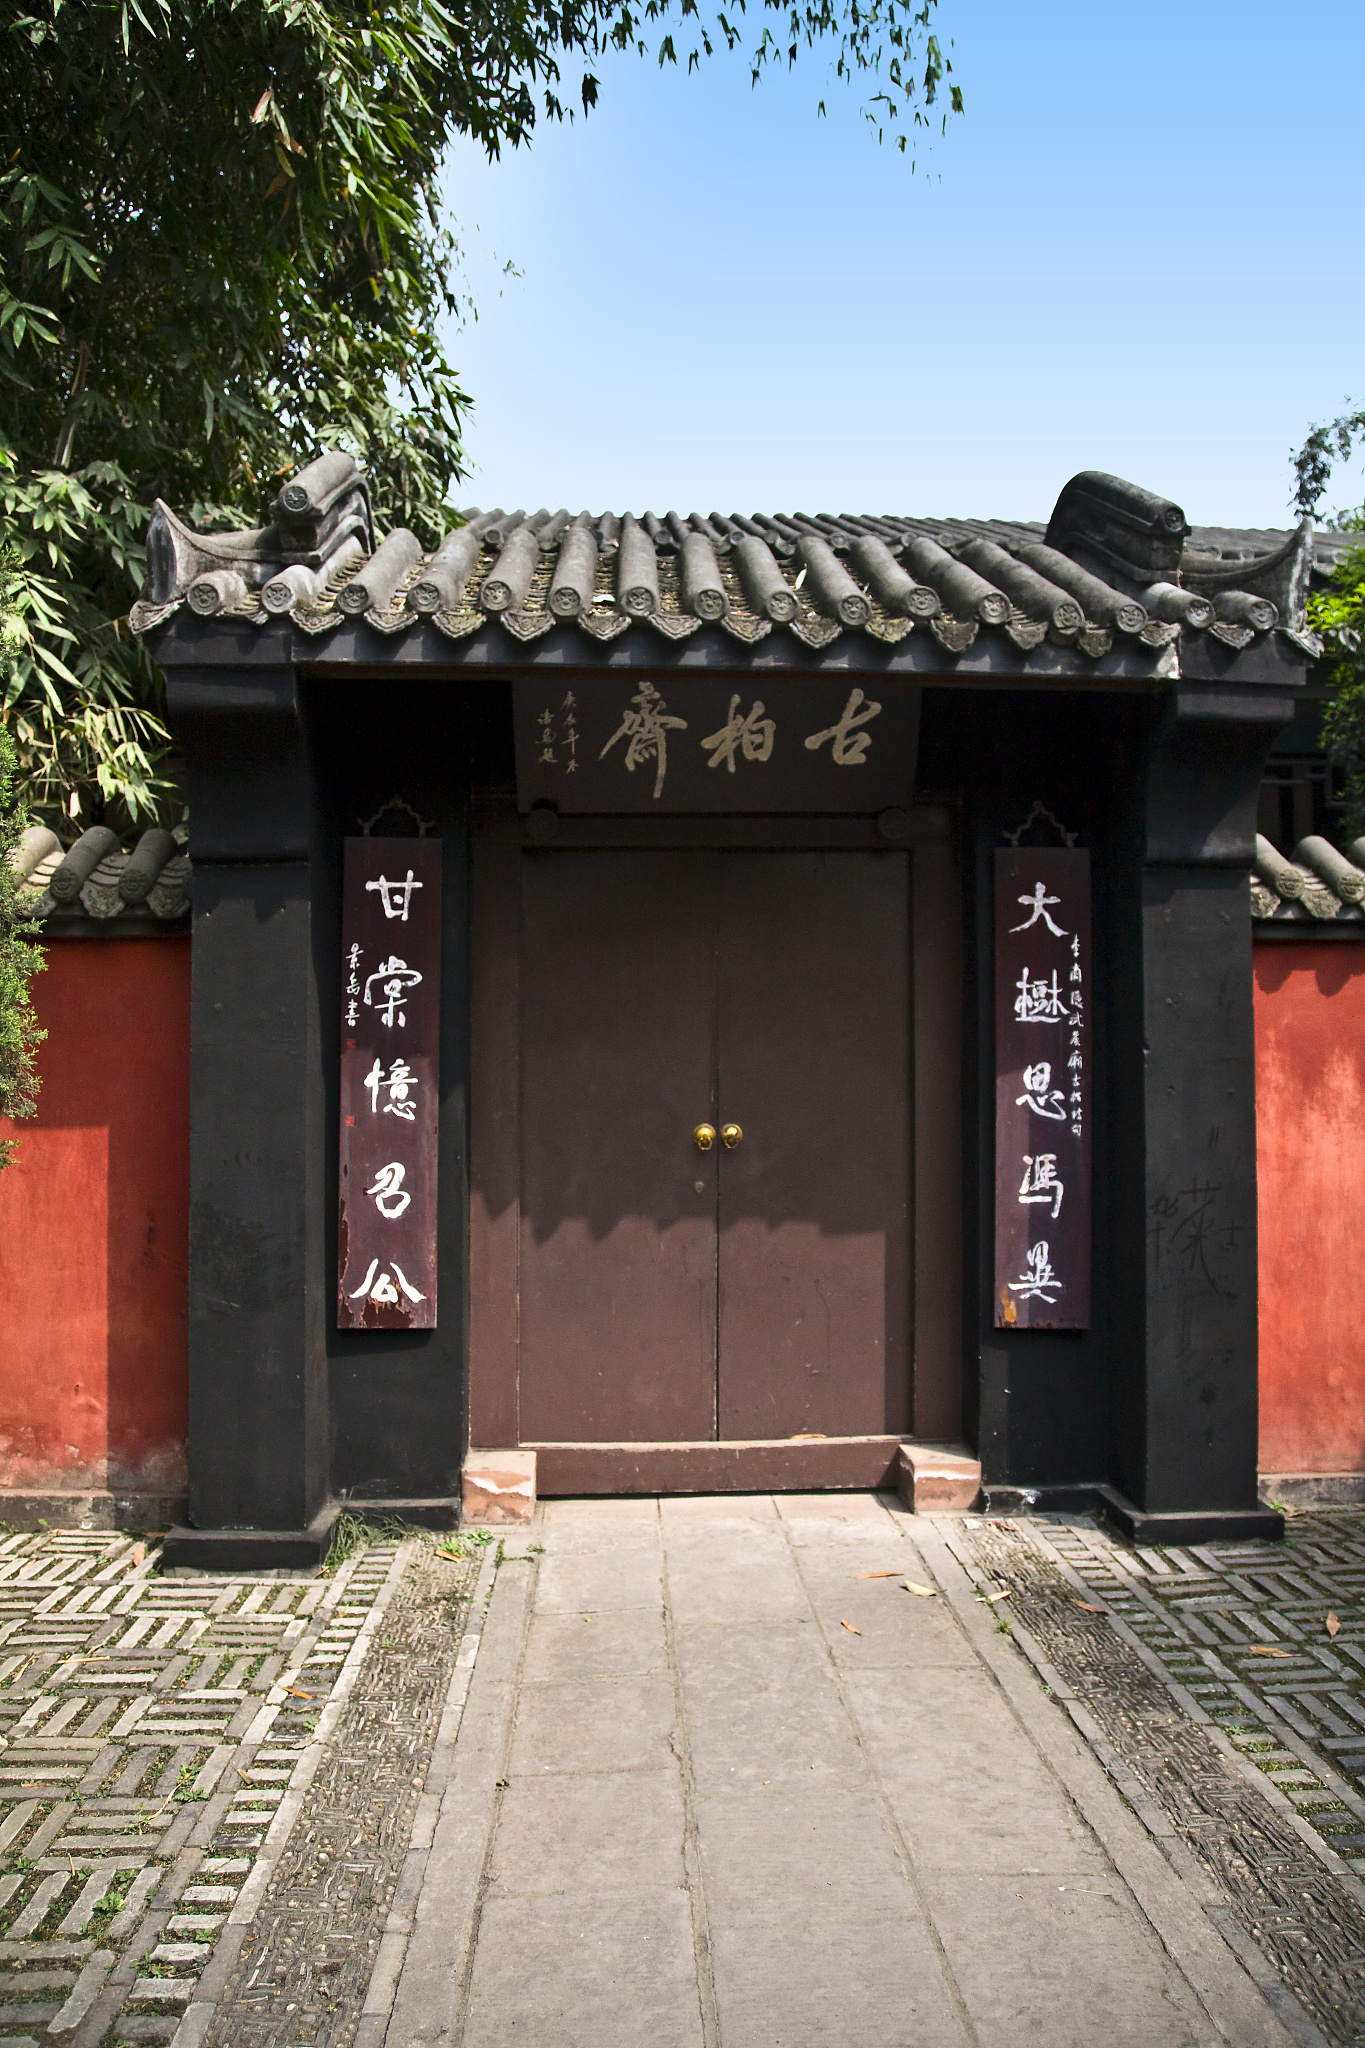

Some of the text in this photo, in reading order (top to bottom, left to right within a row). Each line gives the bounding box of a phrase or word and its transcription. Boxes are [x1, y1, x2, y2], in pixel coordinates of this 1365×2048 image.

[350, 869, 426, 1304] 甘棠憶召公
